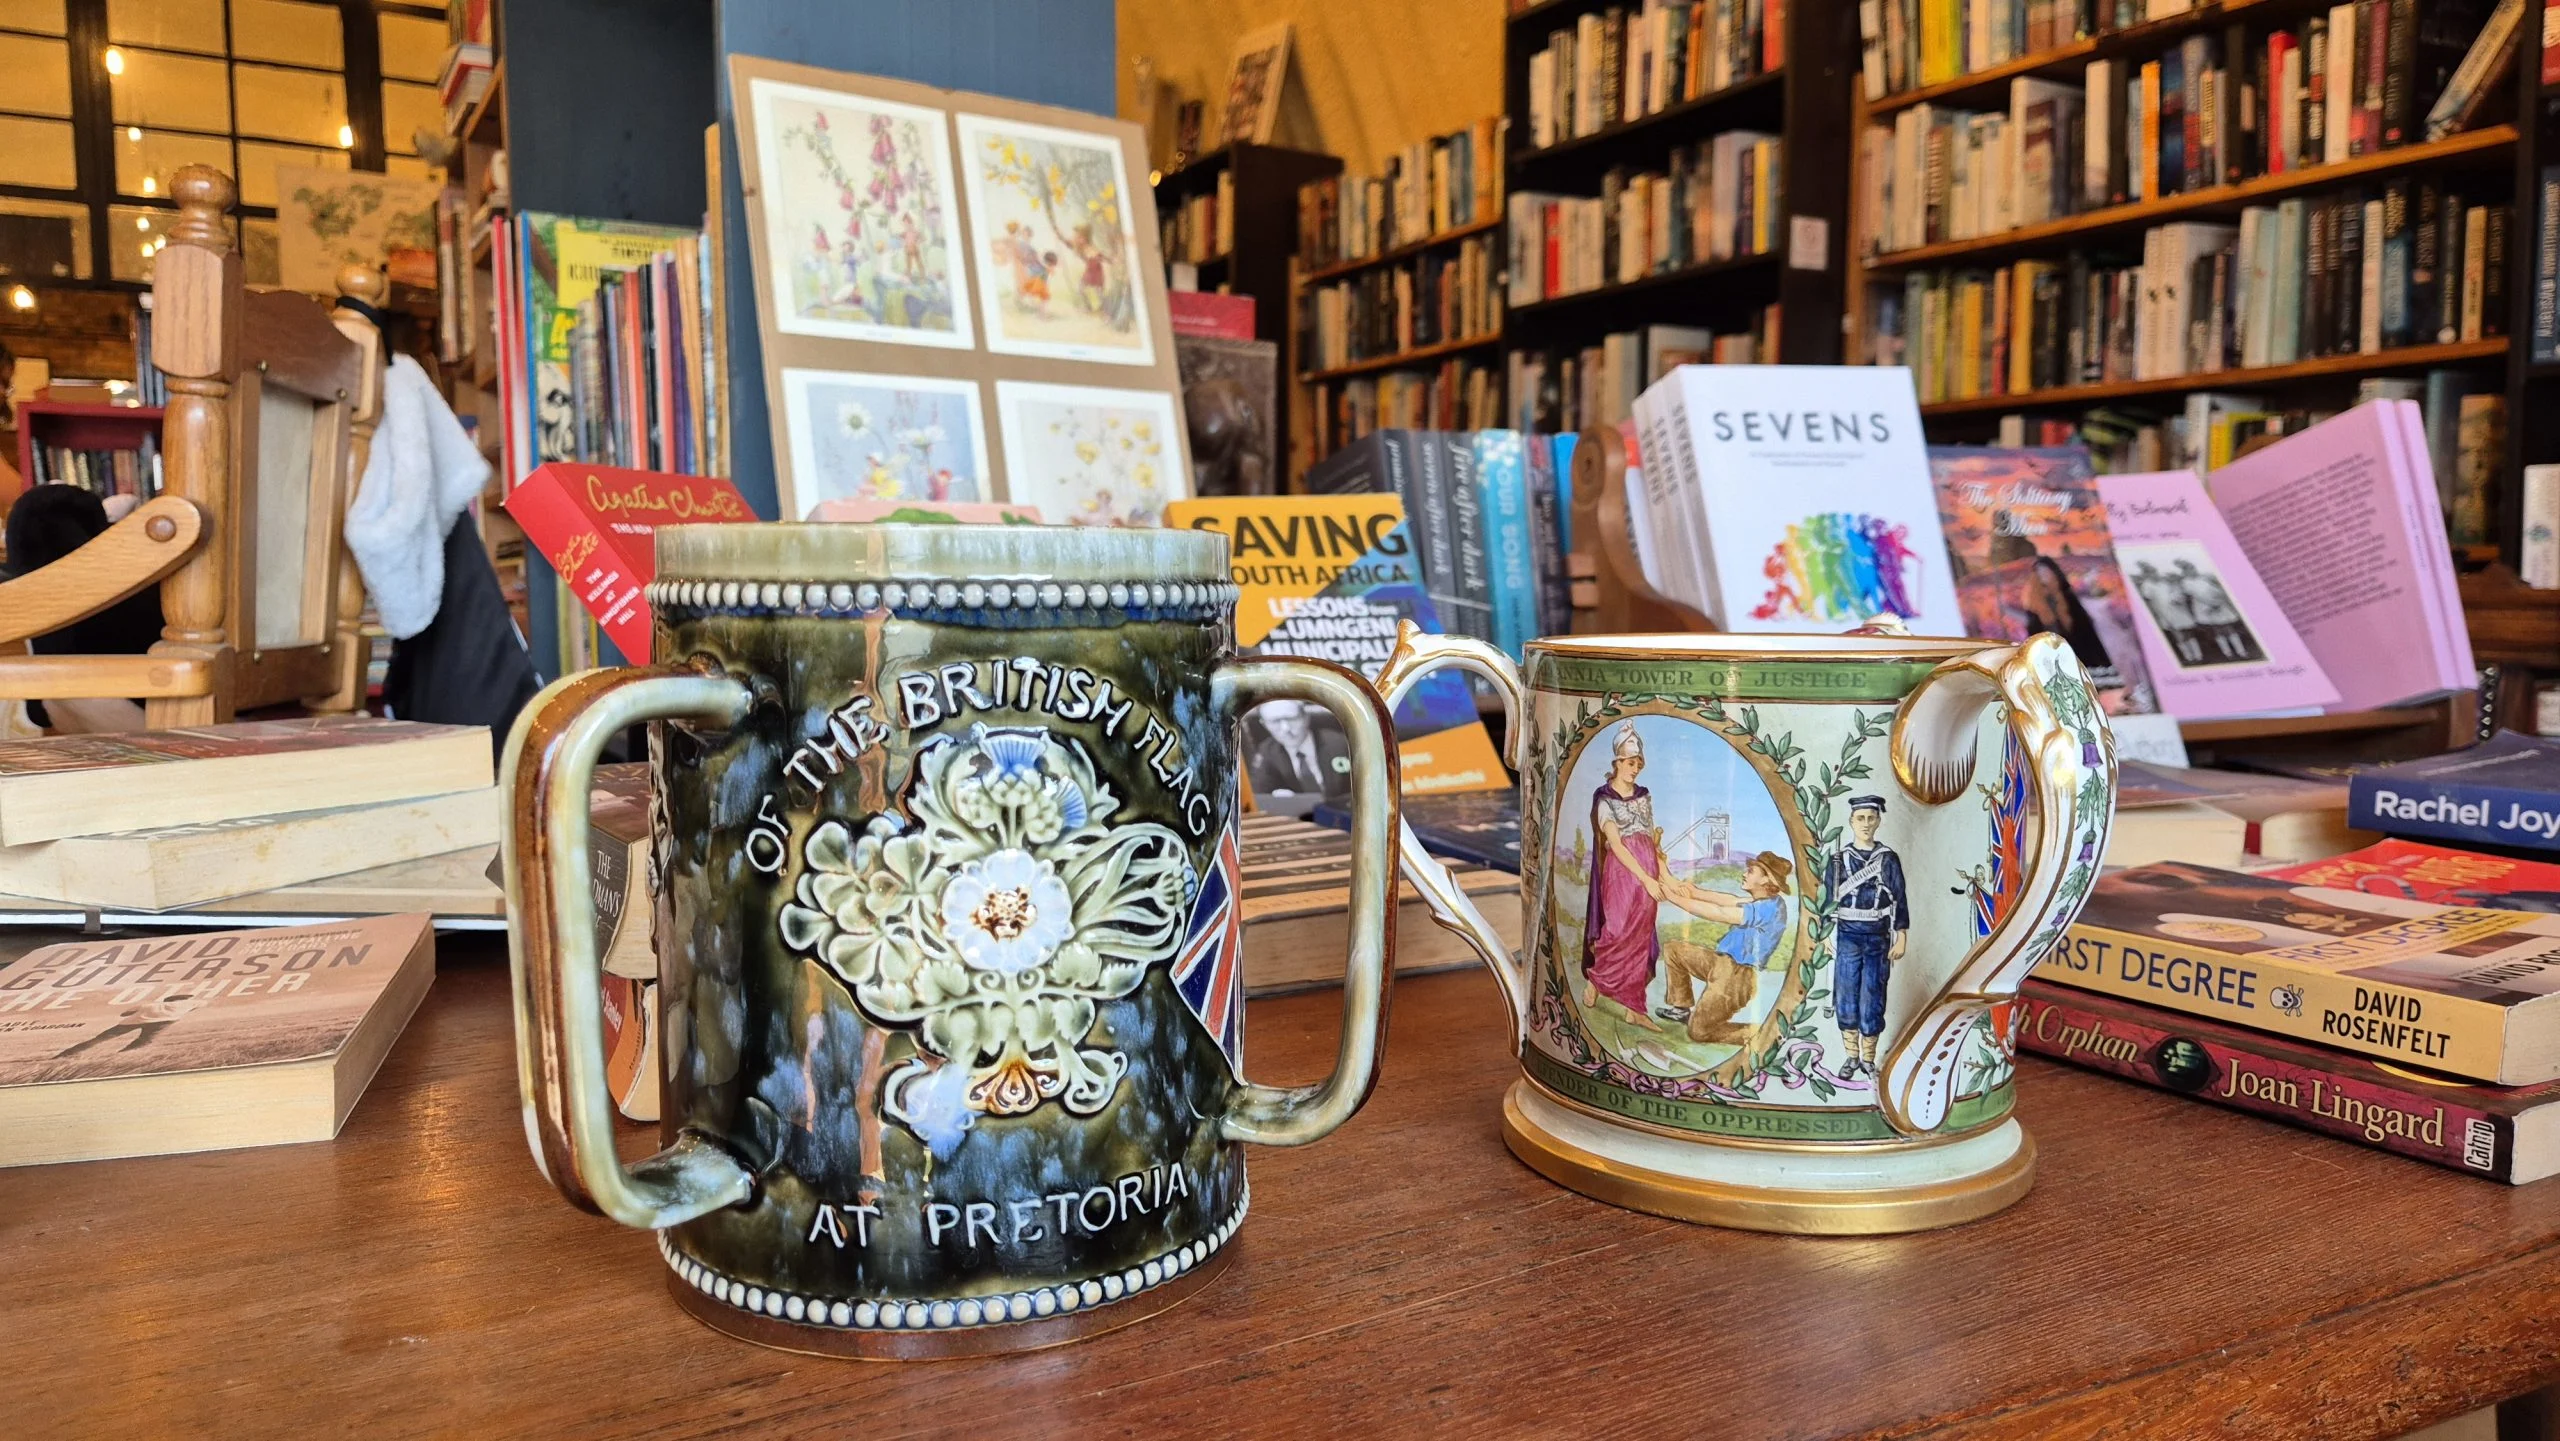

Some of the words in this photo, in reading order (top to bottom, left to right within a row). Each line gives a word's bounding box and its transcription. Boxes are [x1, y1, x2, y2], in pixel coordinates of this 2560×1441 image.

[1713, 410, 1891, 443] SEVENS
[587, 474, 669, 517] Agatha
[669, 485, 743, 518] Christie
[1452, 487, 1480, 539] after
[1231, 565, 1306, 586] OUTH
[1315, 563, 1411, 585] AFRICA
[1462, 540, 1486, 591] dark
[1502, 525, 1524, 590] SONG
[1267, 596, 1370, 619] LESSONS
[1286, 617, 1397, 640] UMNGENI
[1260, 638, 1396, 662] MUNICIPAL
[1618, 669, 1694, 686] TOWER
[1754, 671, 1867, 688] JUSTICE
[745, 794, 792, 873] OF
[783, 695, 890, 792] THE
[899, 656, 1133, 737] BRITISH
[1133, 712, 1212, 837] FLAG
[2374, 790, 2490, 828] Rachel
[597, 850, 612, 880] THE
[593, 878, 622, 918] OMAN'S
[2356, 908, 2500, 951] DEGREE
[0, 943, 374, 990] GUTERSON
[33, 936, 241, 969] DAVID
[2047, 935, 2112, 975] RST
[2121, 946, 2257, 1009] DEGREE
[0, 988, 100, 1013] HE
[108, 972, 311, 1006] OTHER
[2354, 987, 2422, 1023] DAVID
[2323, 1009, 2451, 1059] ROSENFELT
[1536, 1058, 1601, 1101] FENDER
[1607, 1091, 1633, 1110] OF
[1640, 1099, 1689, 1122] THE
[1702, 1110, 1869, 1135] OPPRESSED.
[2036, 1004, 2139, 1064] Orphan
[2221, 1057, 2299, 1108] Joan
[2310, 1078, 2445, 1148] Lingard
[2465, 1121, 2496, 1169] Catnip
[808, 1203, 883, 1249] AT
[926, 1162, 1190, 1247] PRETORIA
